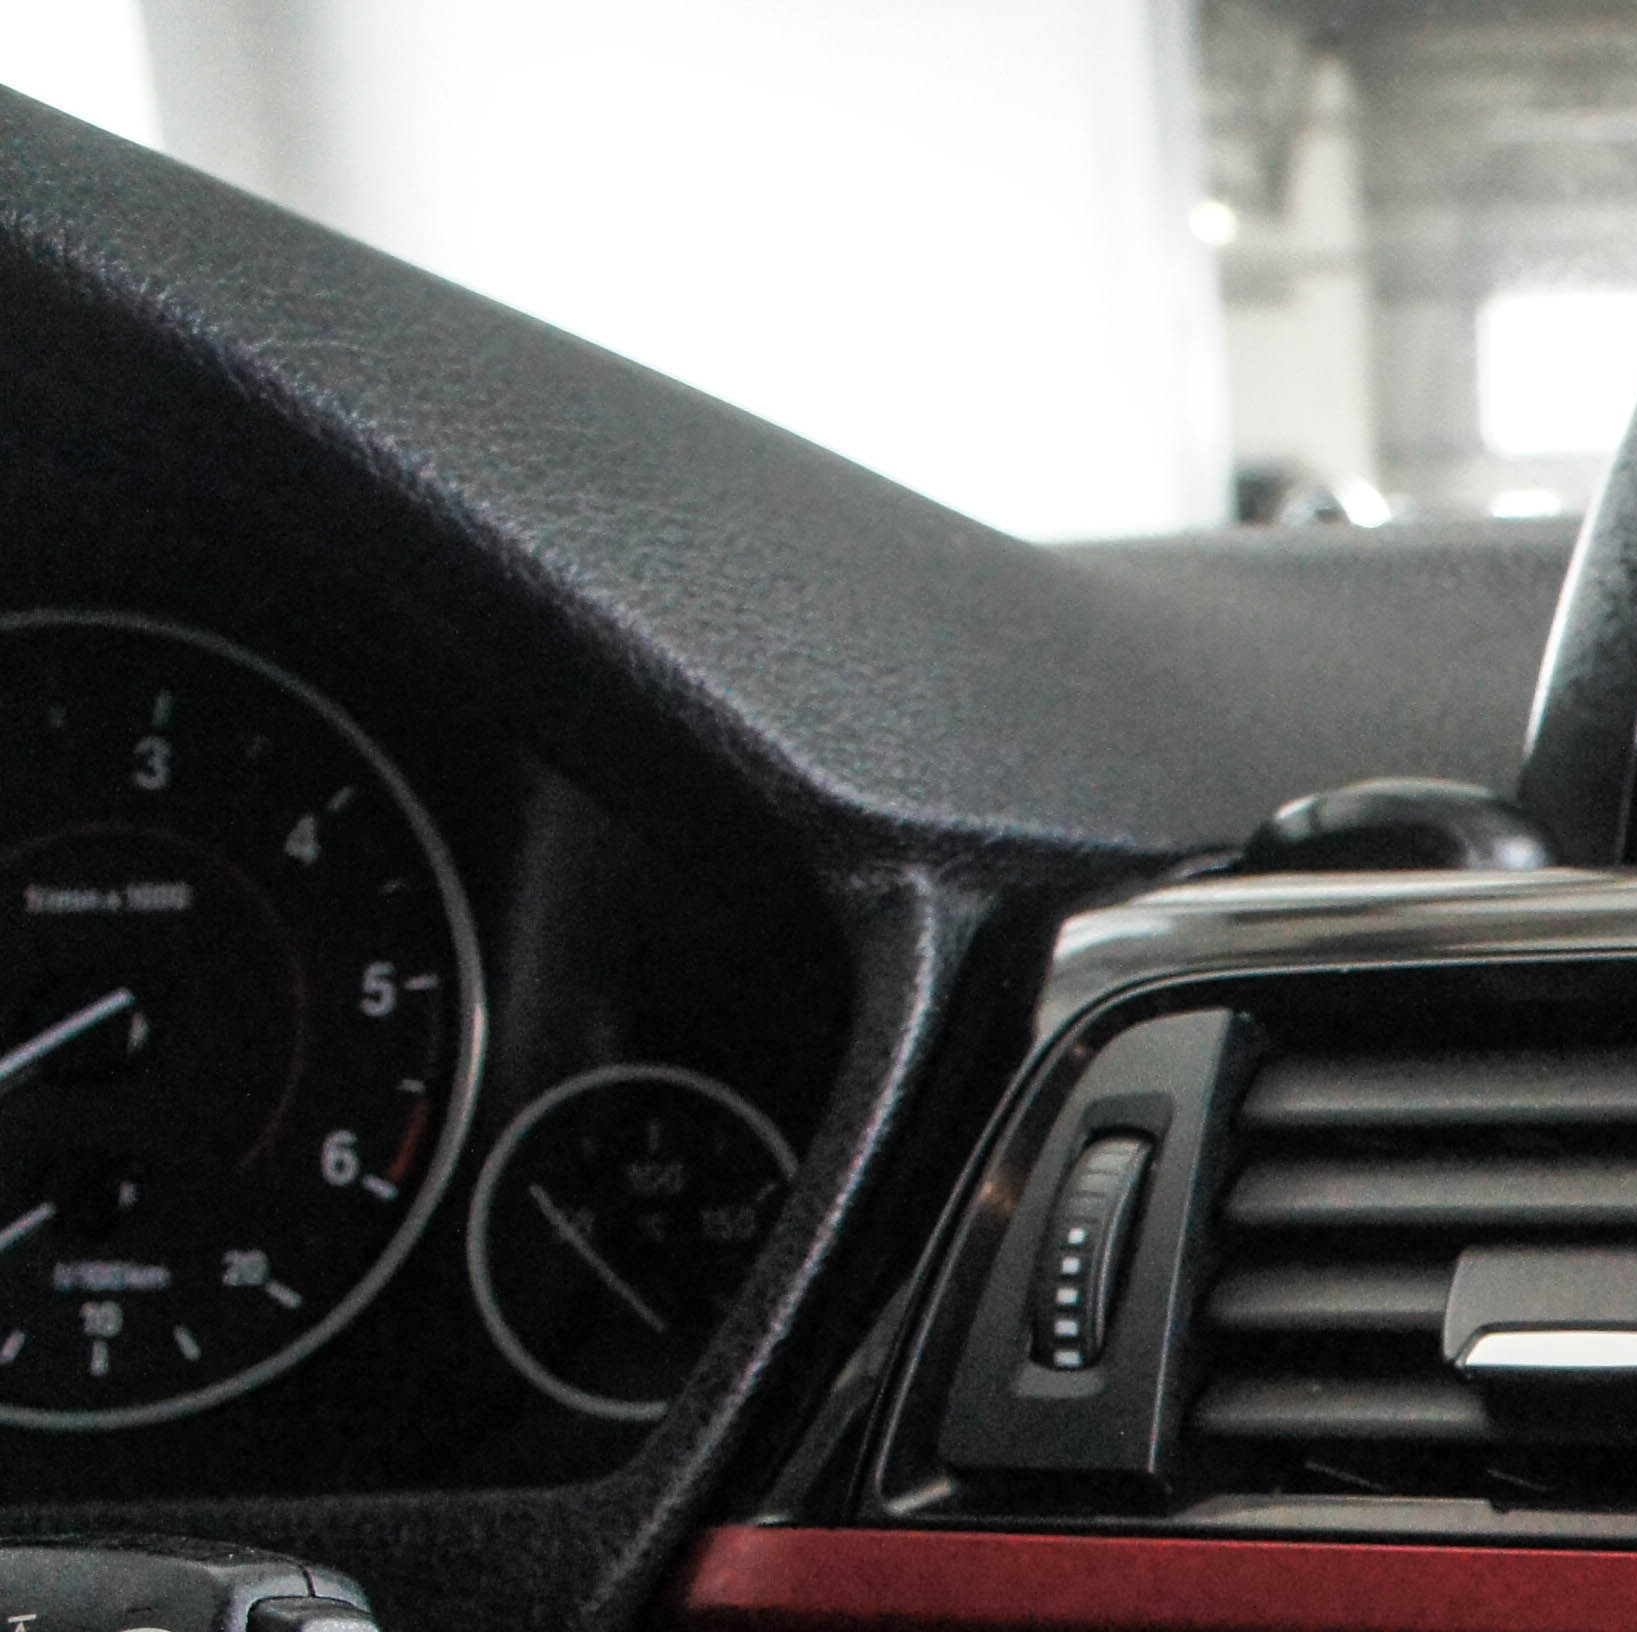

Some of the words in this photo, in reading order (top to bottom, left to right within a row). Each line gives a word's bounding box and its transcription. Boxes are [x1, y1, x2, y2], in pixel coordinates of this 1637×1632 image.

[135, 736, 170, 790] 3
[284, 815, 321, 864] 4
[361, 962, 396, 1017] 5
[321, 1130, 359, 1186] 6
